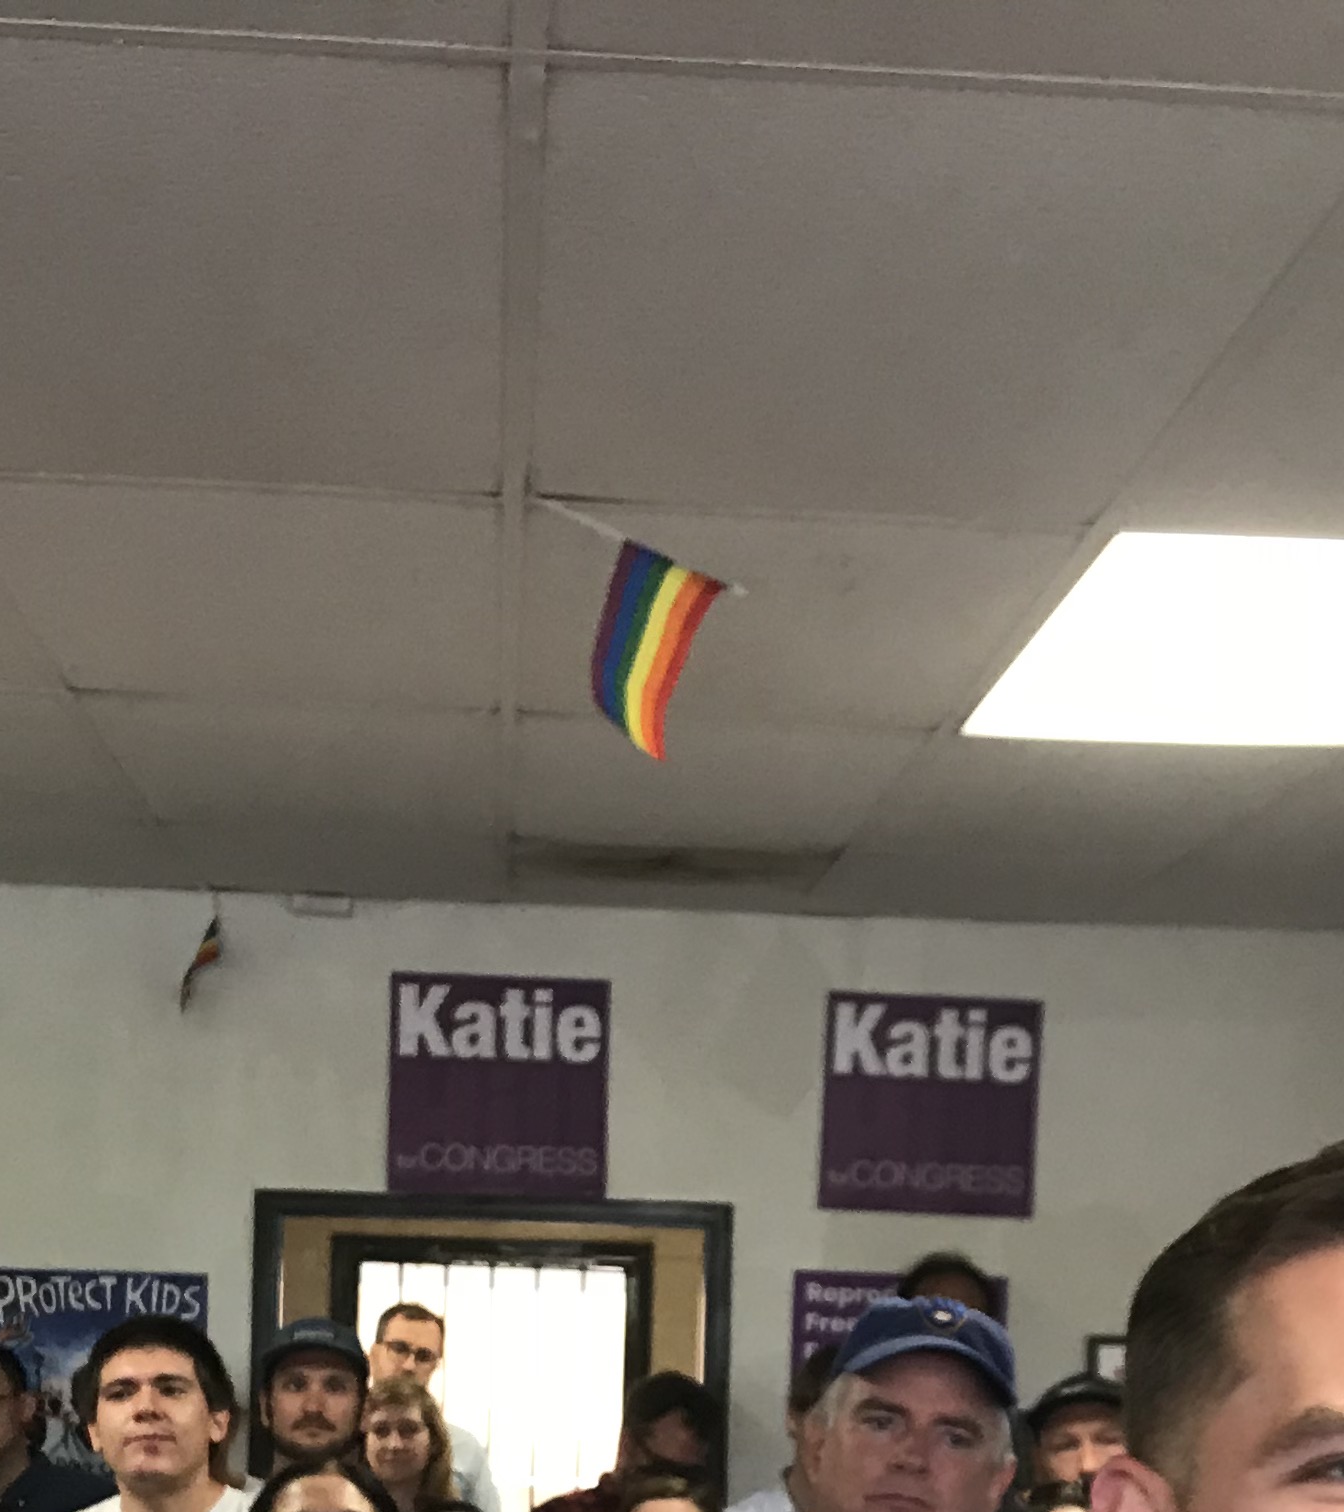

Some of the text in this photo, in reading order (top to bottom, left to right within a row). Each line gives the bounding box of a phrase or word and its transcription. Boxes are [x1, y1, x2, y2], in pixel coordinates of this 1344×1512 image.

[399, 983, 602, 1063] Katie
[833, 1001, 1033, 1083] Katie
[420, 1141, 599, 1176] CONGRESS
[125, 1276, 201, 1320] KIDS
